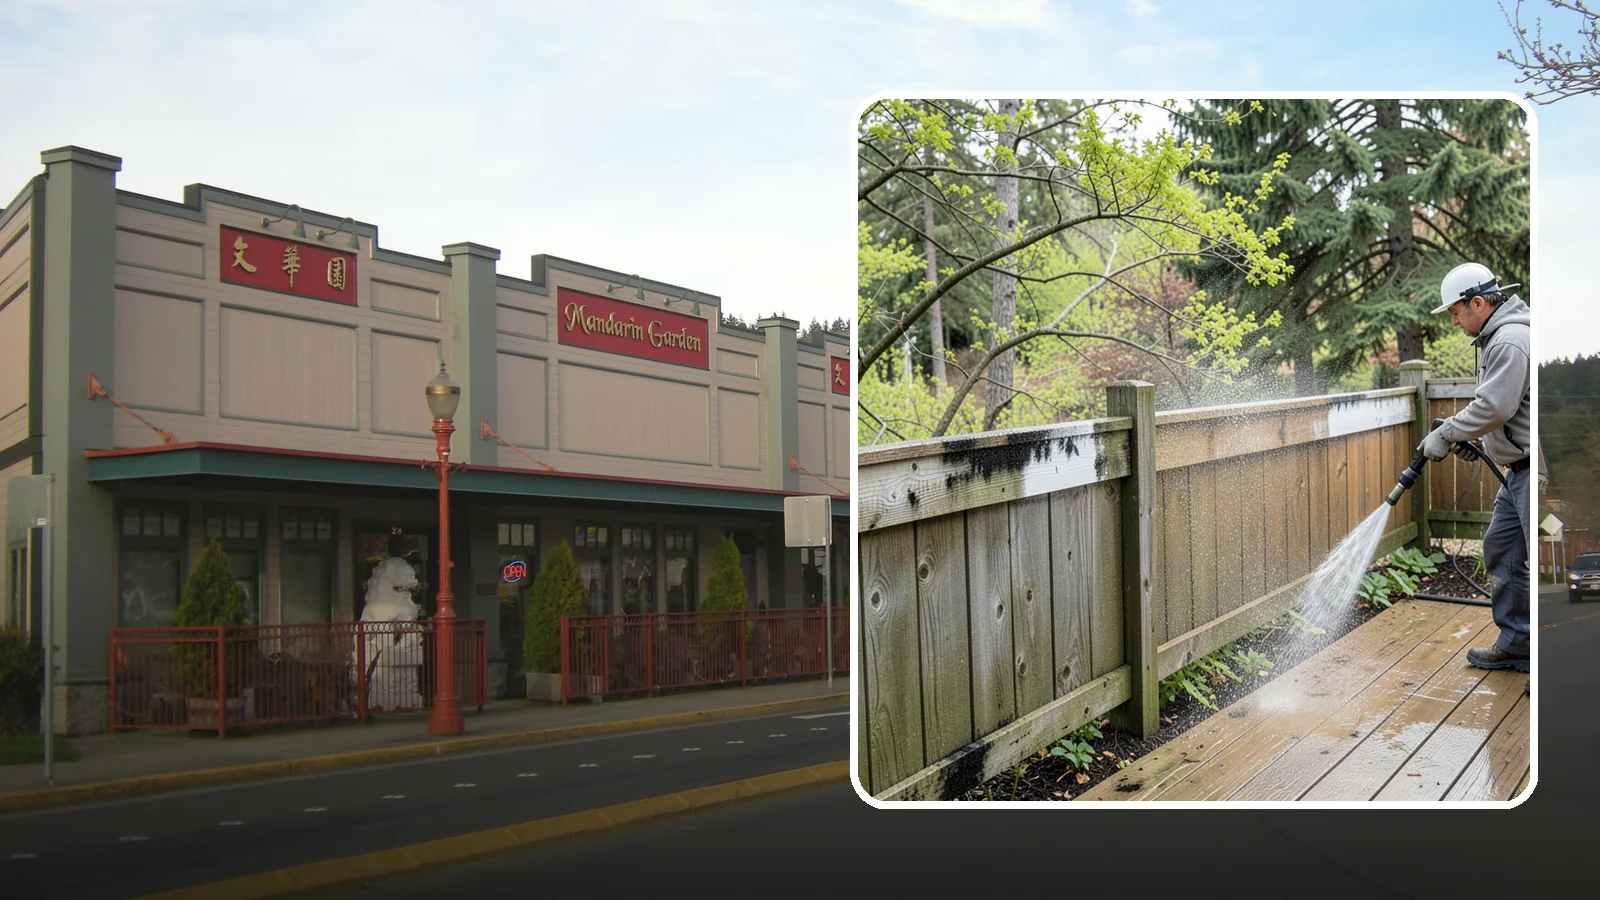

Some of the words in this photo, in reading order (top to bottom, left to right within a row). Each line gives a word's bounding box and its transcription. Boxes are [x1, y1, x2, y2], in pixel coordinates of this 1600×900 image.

[231, 236, 346, 291] 文華園
[564, 302, 644, 341] Mandarin
[648, 320, 701, 352] Garden
[503, 565, 526, 578] OPEN
